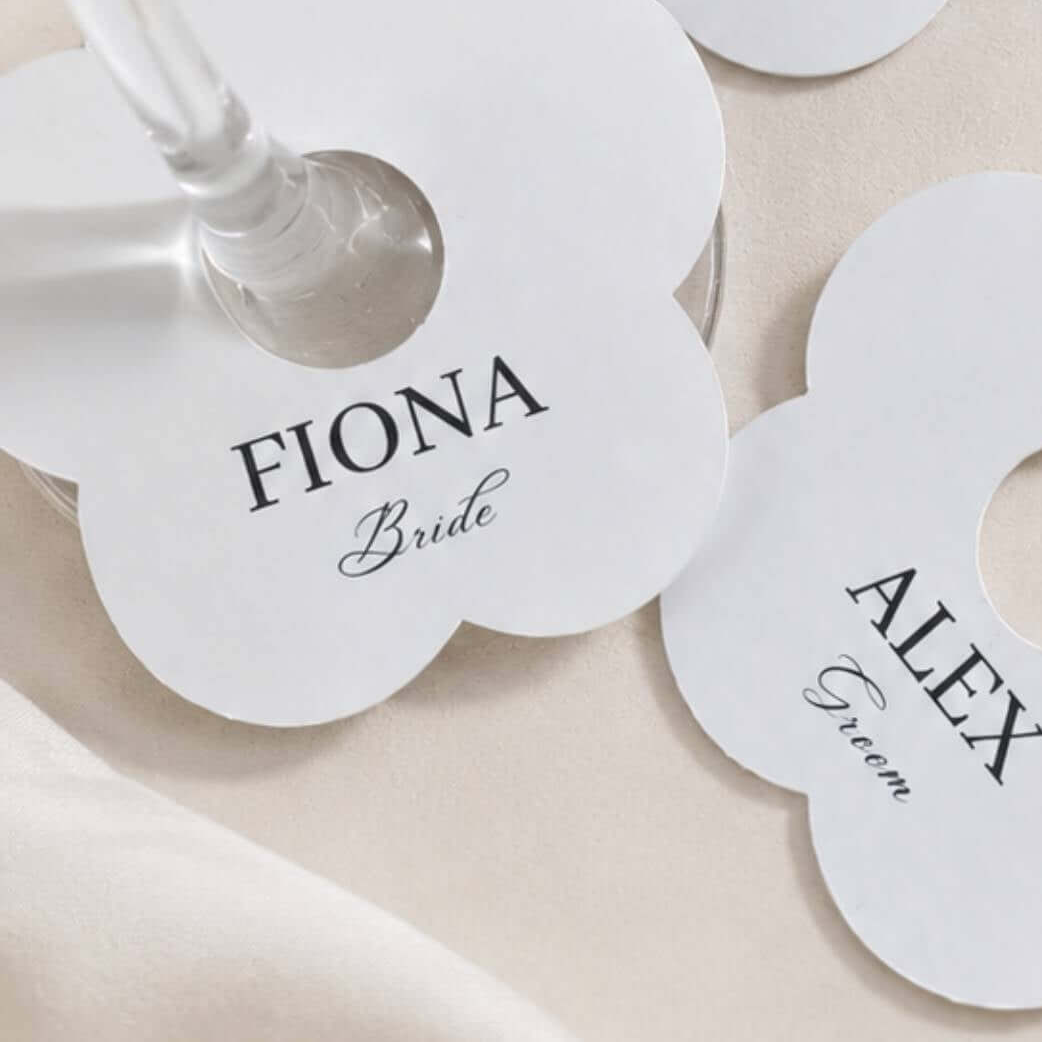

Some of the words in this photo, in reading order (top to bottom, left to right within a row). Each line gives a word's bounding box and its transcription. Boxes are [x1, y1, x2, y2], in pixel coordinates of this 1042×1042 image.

[230, 355, 549, 512] FIONA
[338, 468, 509, 577] Bride
[802, 654, 911, 803] Groom
